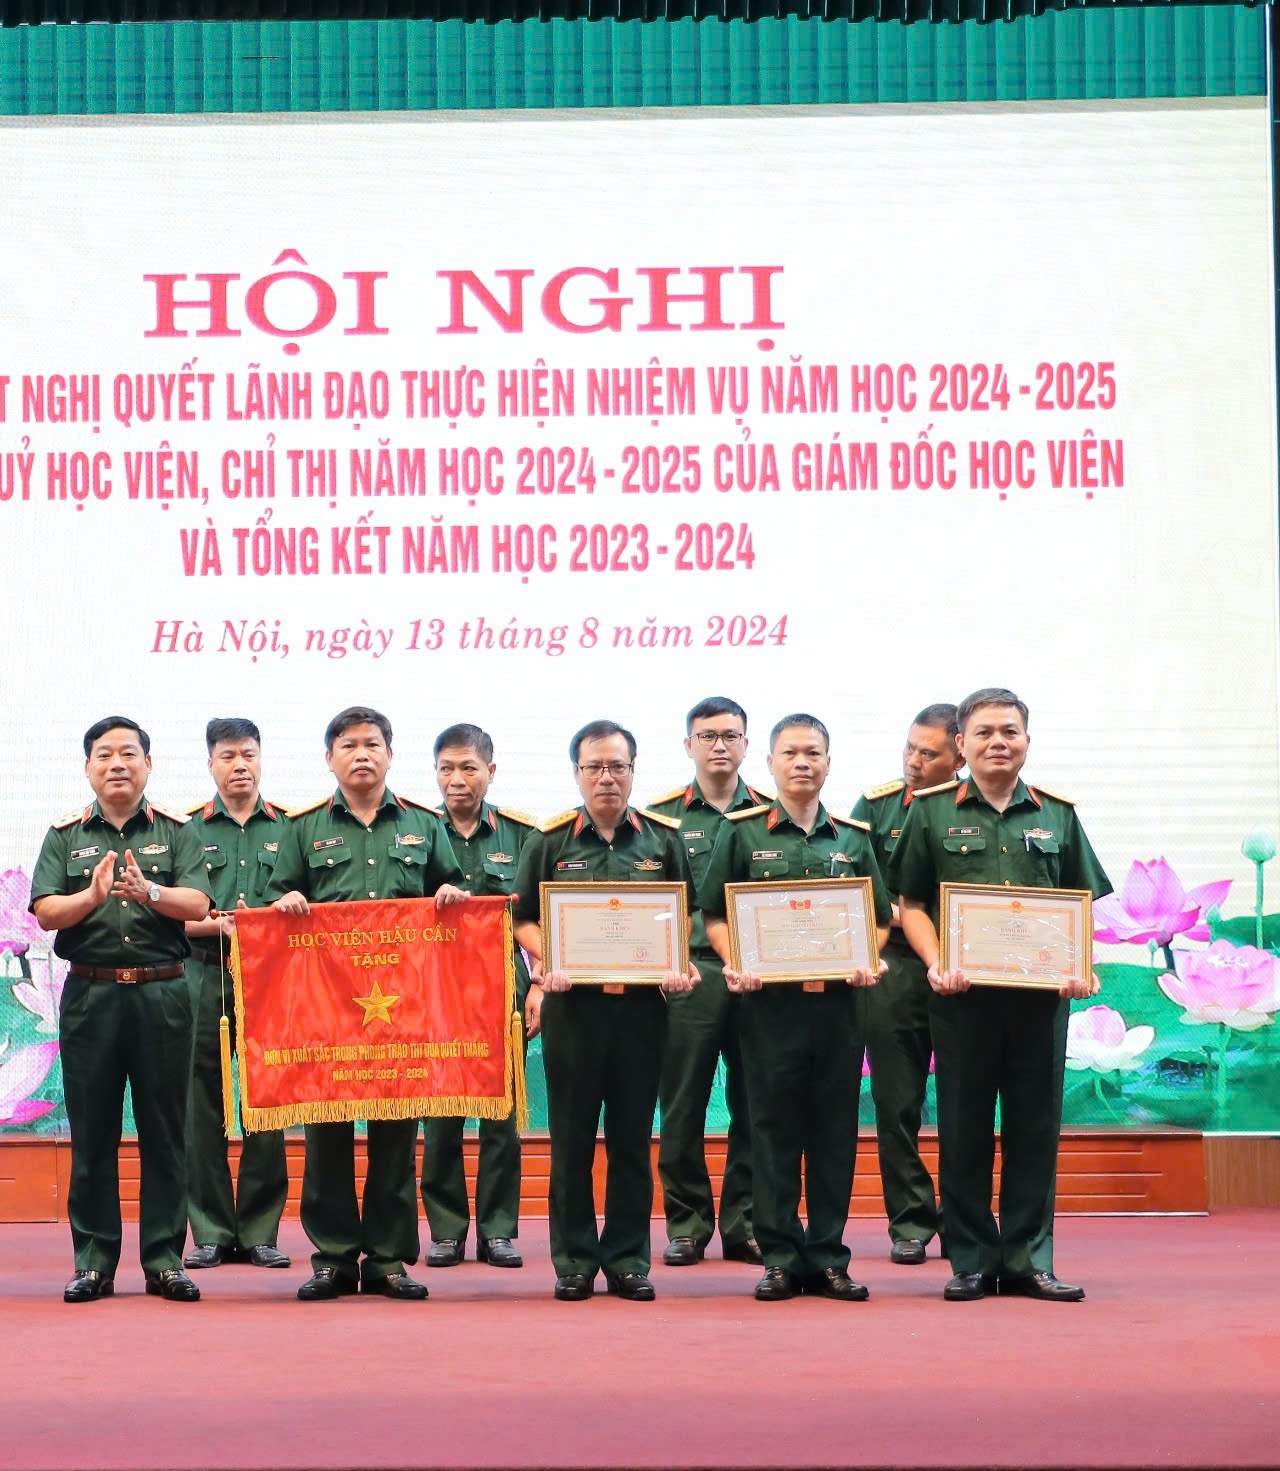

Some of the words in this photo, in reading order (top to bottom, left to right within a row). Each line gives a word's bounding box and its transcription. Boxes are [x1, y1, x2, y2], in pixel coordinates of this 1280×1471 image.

[144, 248, 389, 356] HỘI
[437, 265, 785, 351] NGHỊ
[22, 374, 100, 433] NGHỊ
[114, 357, 215, 427] QUYẾT
[226, 363, 312, 420] LÃNH
[324, 370, 389, 430] ĐẠO
[401, 365, 485, 429] THỰC
[498, 358, 574, 427] HIỆN
[587, 357, 695, 426] NHIỆM
[708, 366, 748, 425] VỤ
[762, 356, 838, 413] NĂM
[851, 363, 917, 423] HỌC
[47, 451, 112, 511] HỌC
[124, 440, 208, 510] VIỆN,
[222, 433, 275, 498] CHỈ
[287, 450, 336, 508] THỊ
[350, 439, 426, 496] NĂM
[439, 447, 504, 507] HỌC
[714, 427, 780, 492] CỦA
[792, 432, 878, 491] GIÁM
[890, 423, 956, 490] ĐỐC
[969, 440, 1035, 501] HỌC
[1047, 429, 1124, 499] VIỆN
[180, 518, 222, 576] VÀ
[233, 508, 319, 576] TỔNG
[332, 511, 391, 574] KẾT
[403, 517, 479, 573] NĂM
[492, 524, 557, 583] HỌC
[153, 621, 202, 652] Hà
[220, 620, 288, 662] Nội,
[306, 619, 388, 658] ngày
[410, 620, 444, 649] 13
[460, 618, 566, 655] tháng
[580, 619, 598, 646] 8
[614, 618, 691, 647] năm
[705, 615, 787, 646] 2024
[288, 933, 326, 952] HỌC
[329, 928, 374, 949] VIỆN
[378, 925, 417, 946] HẬU
[422, 922, 457, 942] CẦN
[351, 952, 400, 968] TẶNG
[332, 1068, 353, 1080] NĂM
[355, 1069, 374, 1083] HỌC
[376, 1069, 398, 1079] 2023
[406, 1068, 429, 1078] 2024
